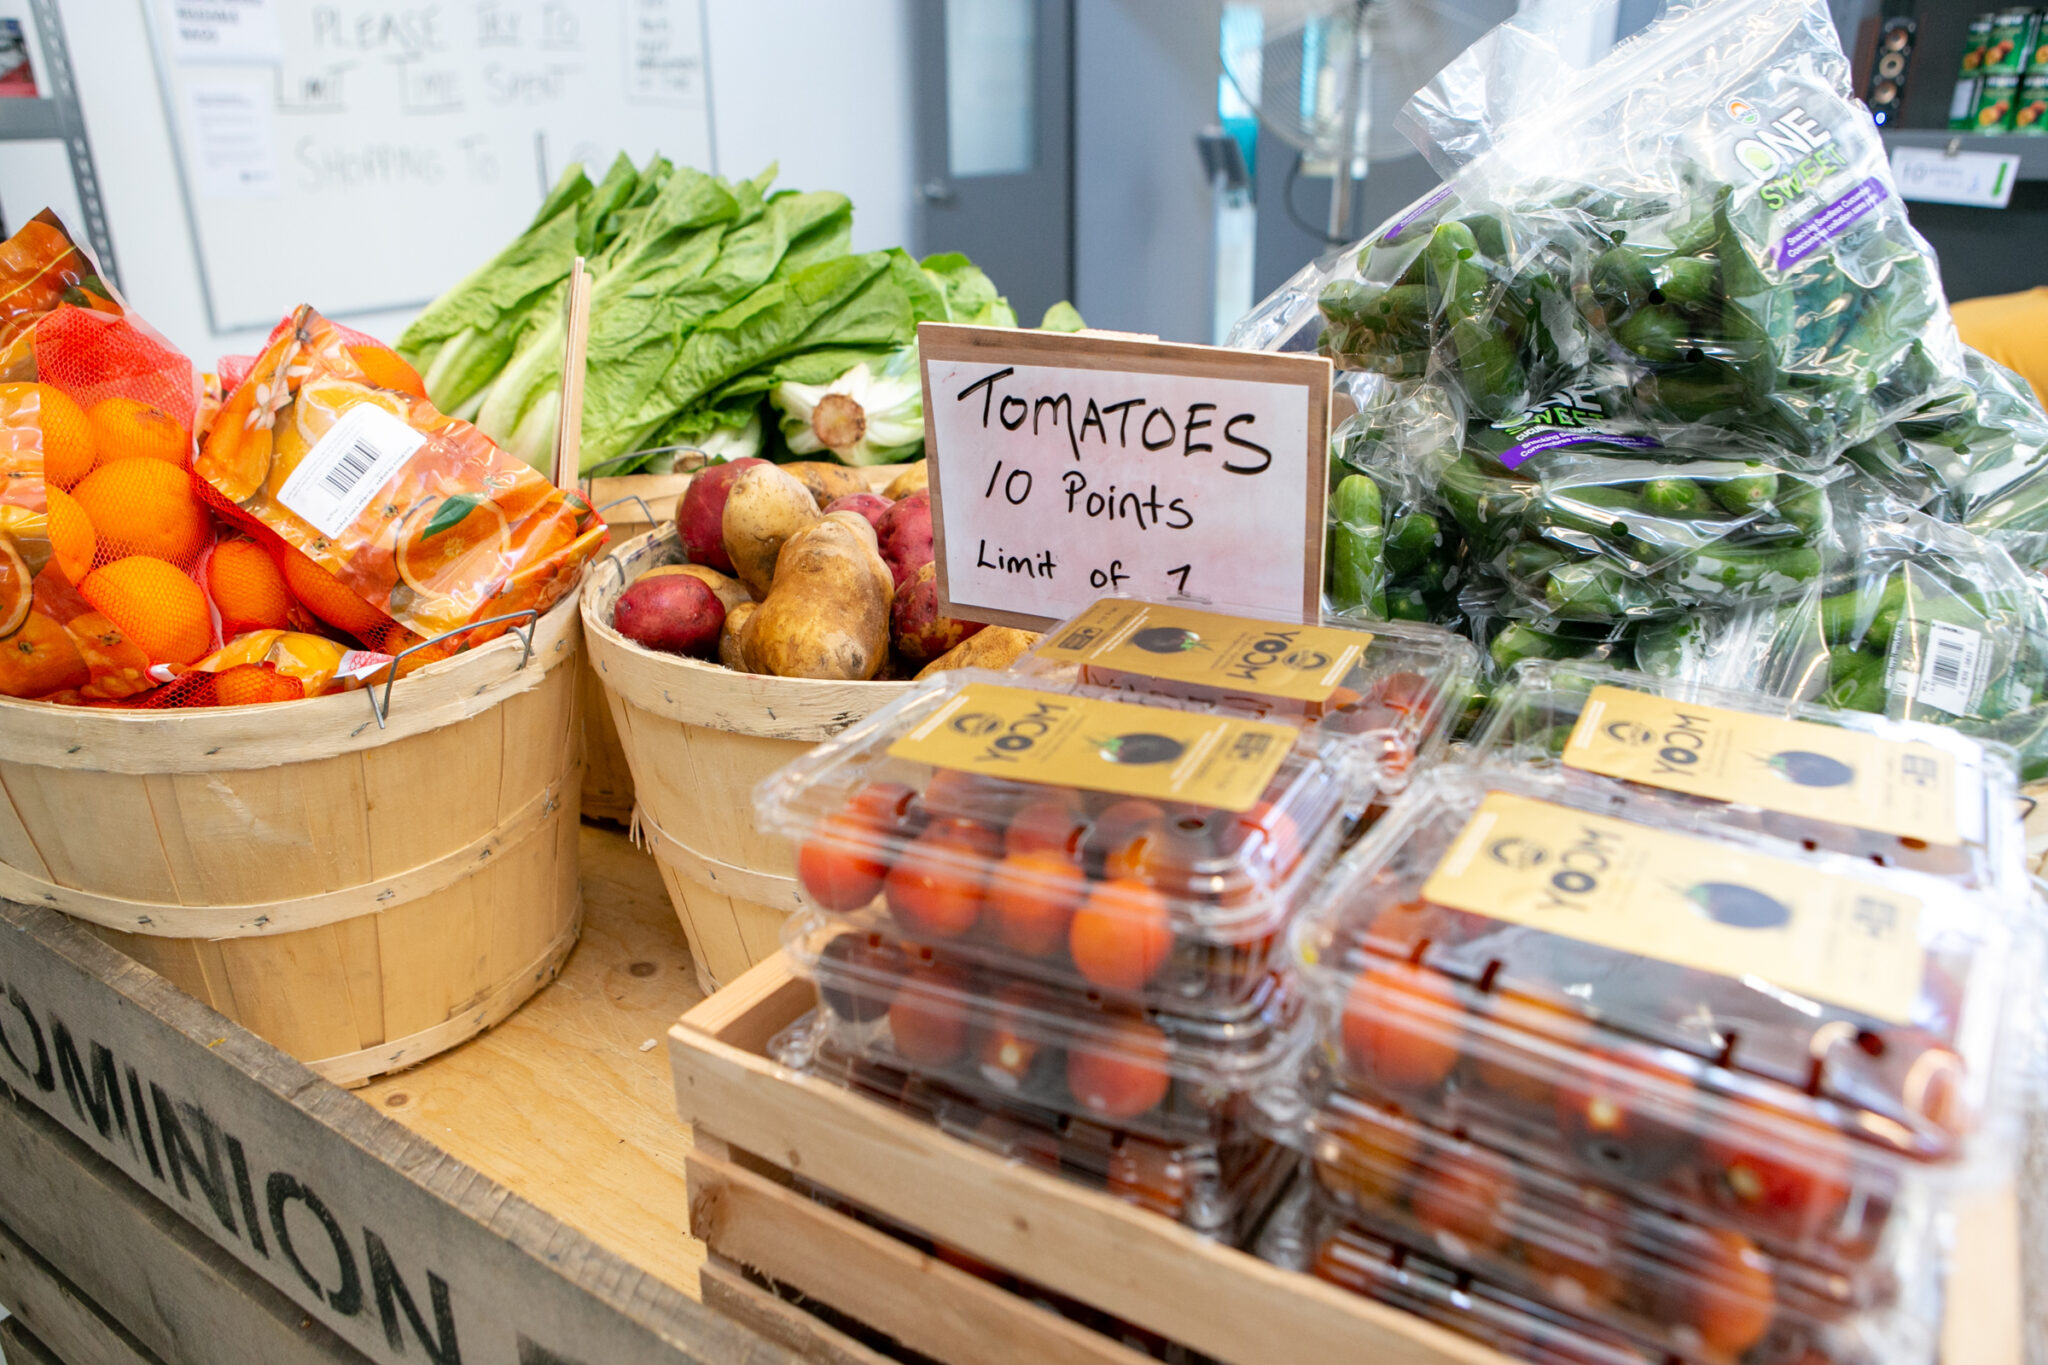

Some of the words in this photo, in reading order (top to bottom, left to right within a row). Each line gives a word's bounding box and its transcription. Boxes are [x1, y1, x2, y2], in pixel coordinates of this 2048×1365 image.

[311, 3, 447, 51] PLEASE
[1735, 106, 1832, 181] ONE
[1760, 142, 1848, 211] SWEET
[958, 367, 1272, 475] TOMATOES
[986, 460, 1032, 505] 10
[1062, 470, 1194, 531] Points
[977, 539, 1057, 579] Limit
[1090, 560, 1131, 591] of
